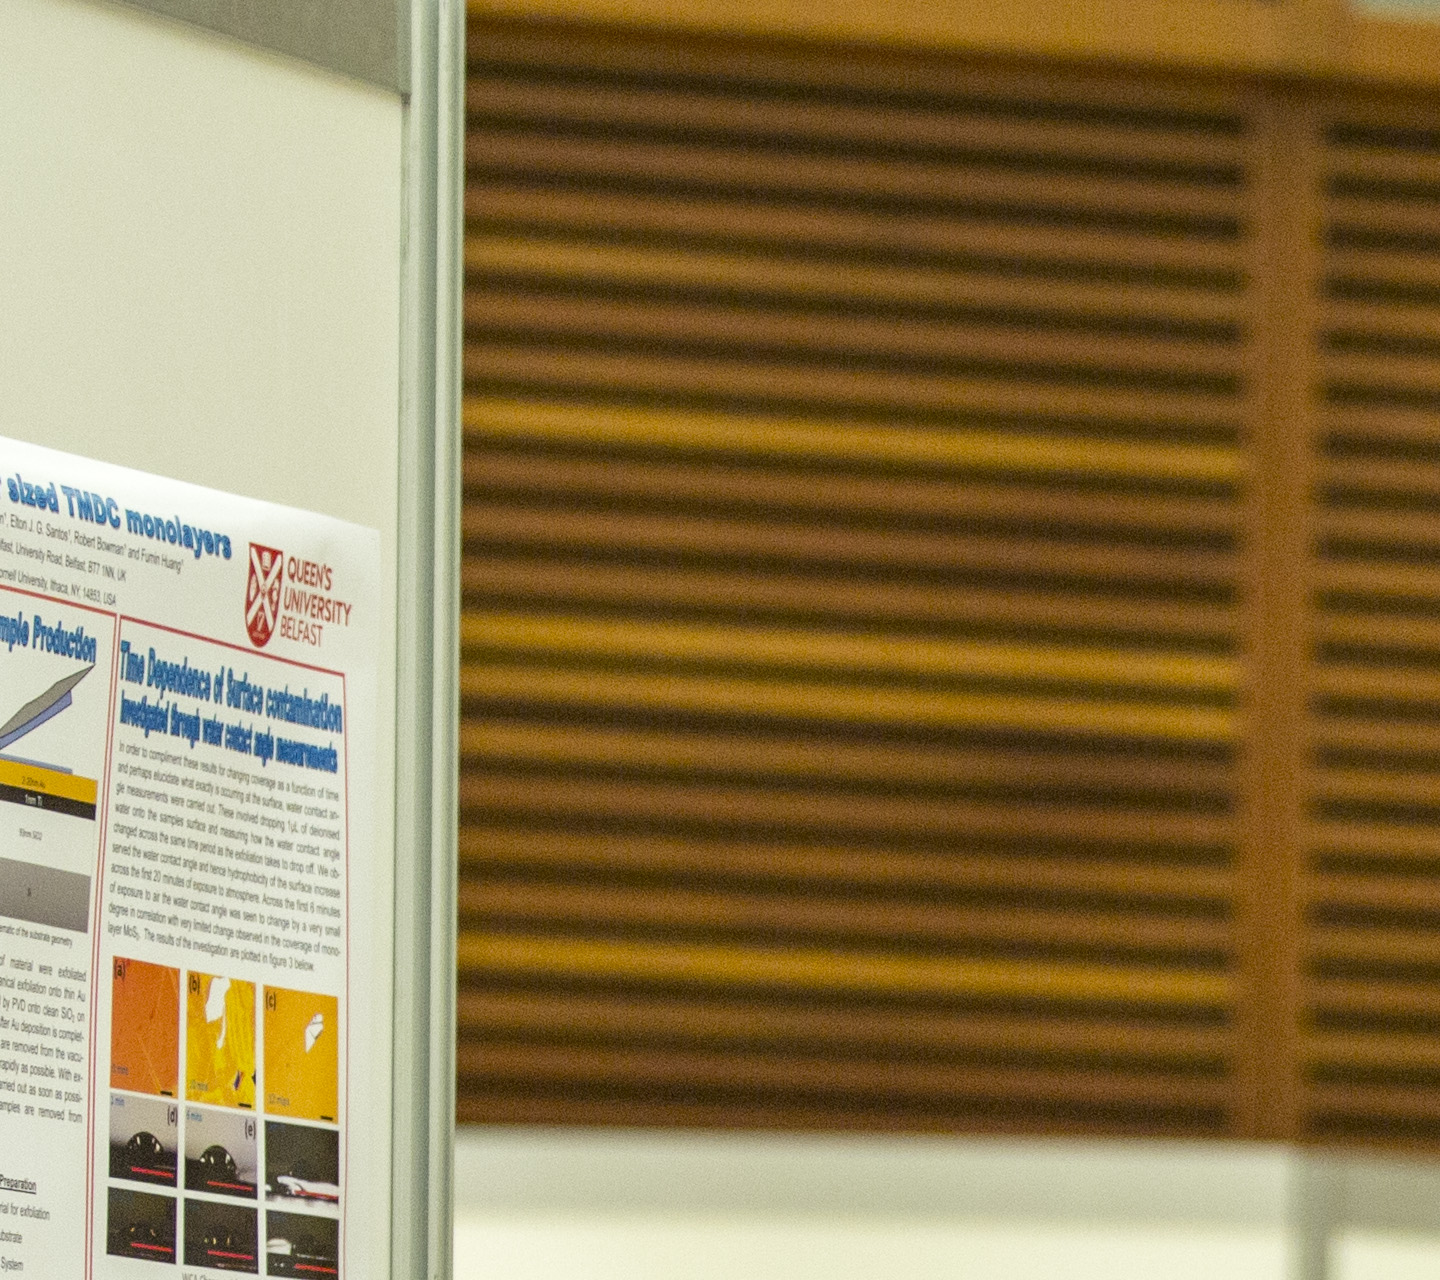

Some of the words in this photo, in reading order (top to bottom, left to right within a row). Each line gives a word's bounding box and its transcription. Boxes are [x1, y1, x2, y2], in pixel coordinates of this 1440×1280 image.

[6, 475, 60, 513] sized
[61, 484, 121, 528] TMDC
[125, 508, 233, 559] monolayers
[287, 555, 334, 592] QUEEN'S
[283, 587, 353, 624] UNIVERSITY
[32, 614, 97, 662] Production
[279, 614, 324, 646] BELFAST
[120, 639, 146, 684] Time
[146, 647, 212, 700] Dependence
[213, 666, 225, 702] of
[225, 667, 264, 714] Surface
[262, 688, 343, 732] contamination
